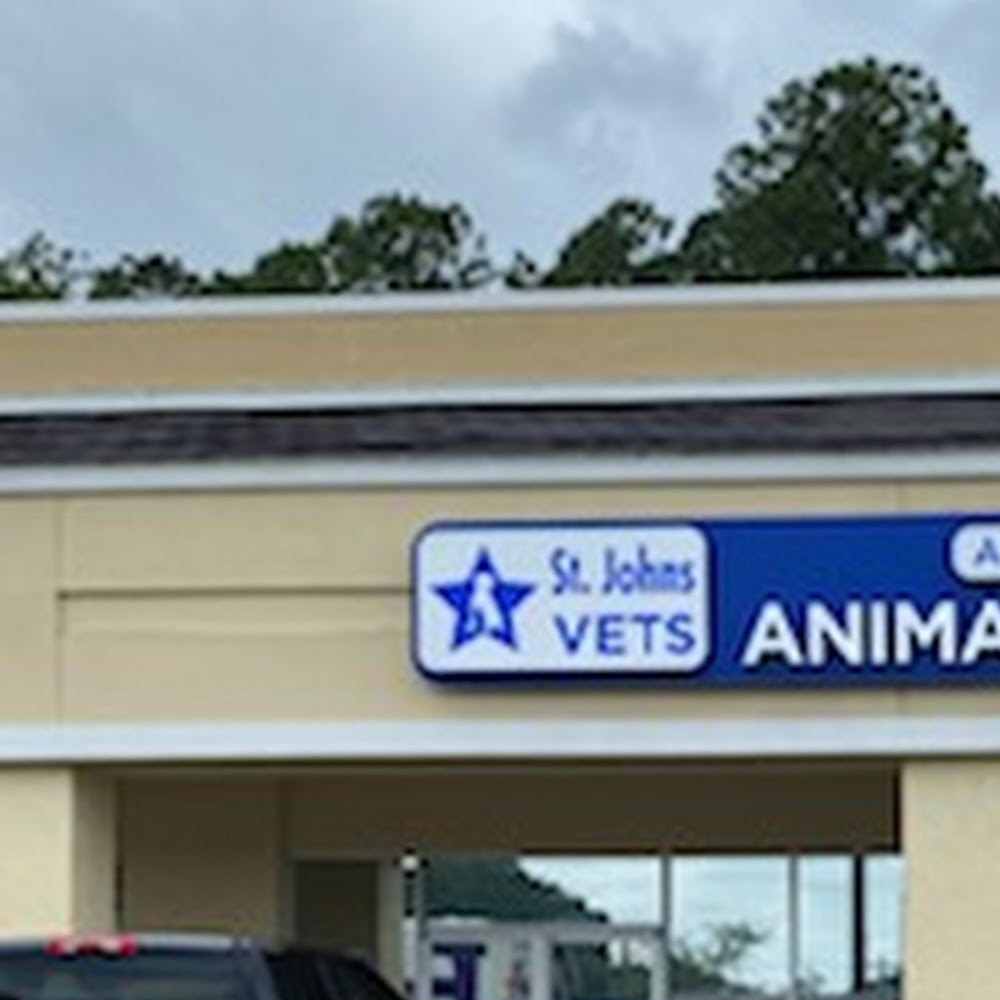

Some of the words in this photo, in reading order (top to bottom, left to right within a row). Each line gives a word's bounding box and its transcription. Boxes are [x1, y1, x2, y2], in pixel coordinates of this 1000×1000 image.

[549, 546, 591, 597] St.
[601, 544, 697, 596] Johns
[553, 611, 697, 658] VETS
